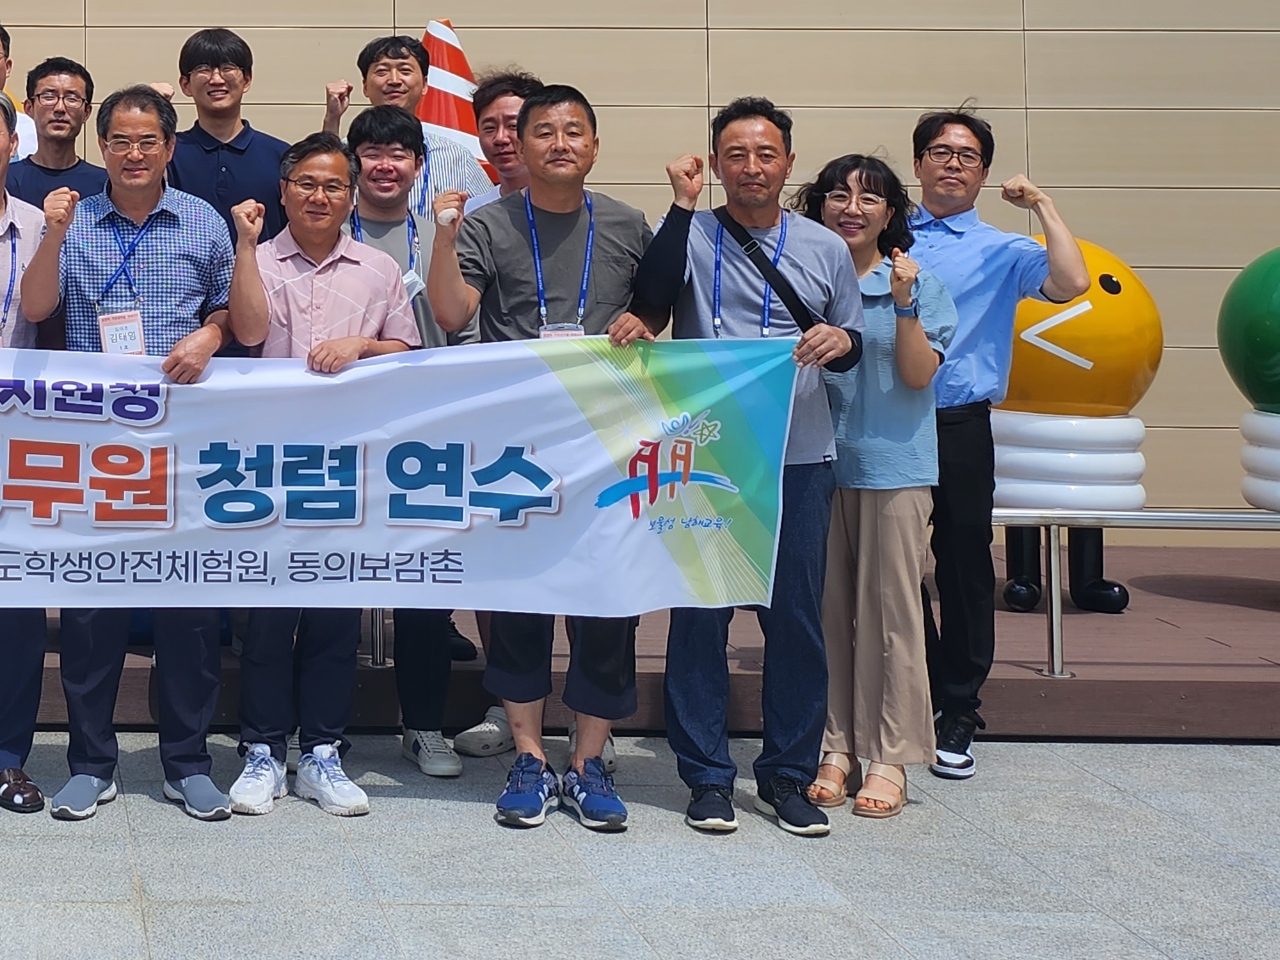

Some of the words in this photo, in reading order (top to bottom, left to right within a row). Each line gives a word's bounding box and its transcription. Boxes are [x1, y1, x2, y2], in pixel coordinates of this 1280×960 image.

[195, 441, 358, 525] 청렴
[385, 440, 556, 523] 연수
[286, 547, 465, 585] 동의보감촌
